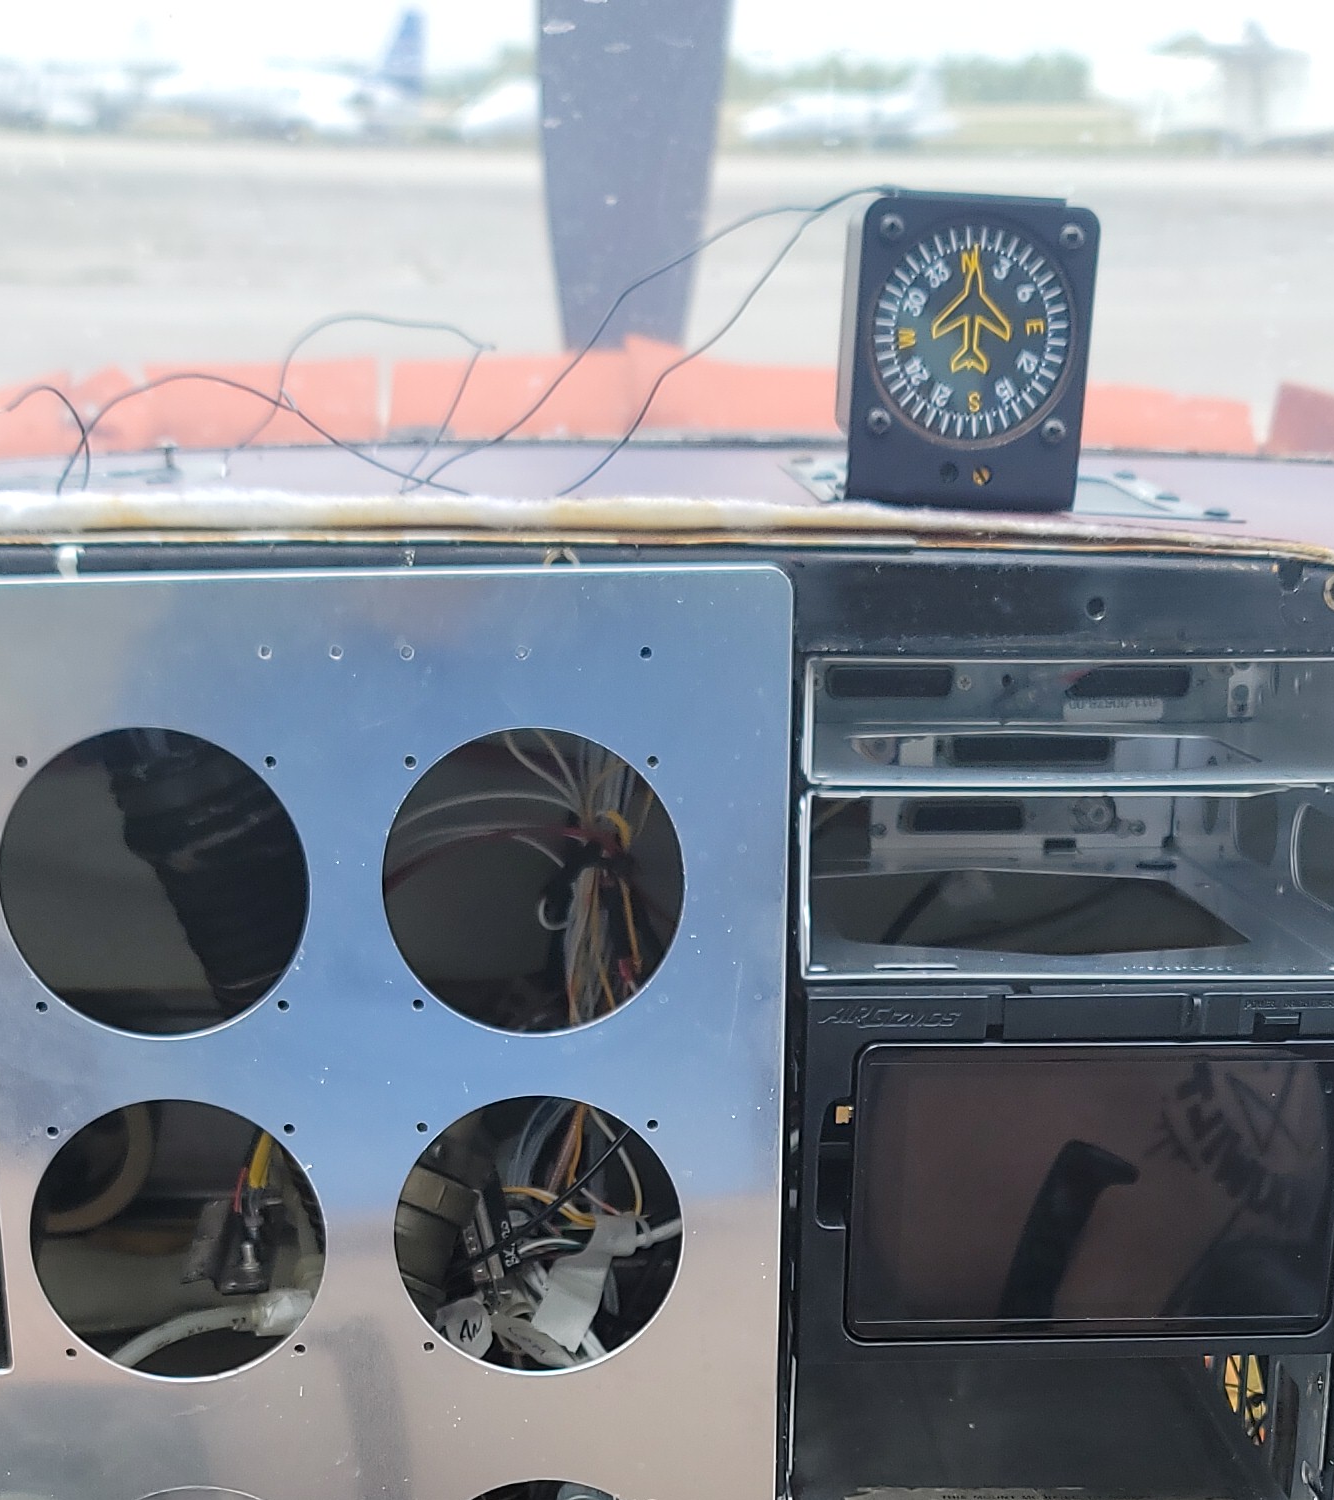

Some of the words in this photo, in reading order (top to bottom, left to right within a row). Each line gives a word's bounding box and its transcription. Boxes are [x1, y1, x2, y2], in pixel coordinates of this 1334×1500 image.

[924, 259, 952, 289] 33
[992, 256, 1012, 280] 3
[1025, 318, 1044, 336] E
[969, 391, 981, 413] S
